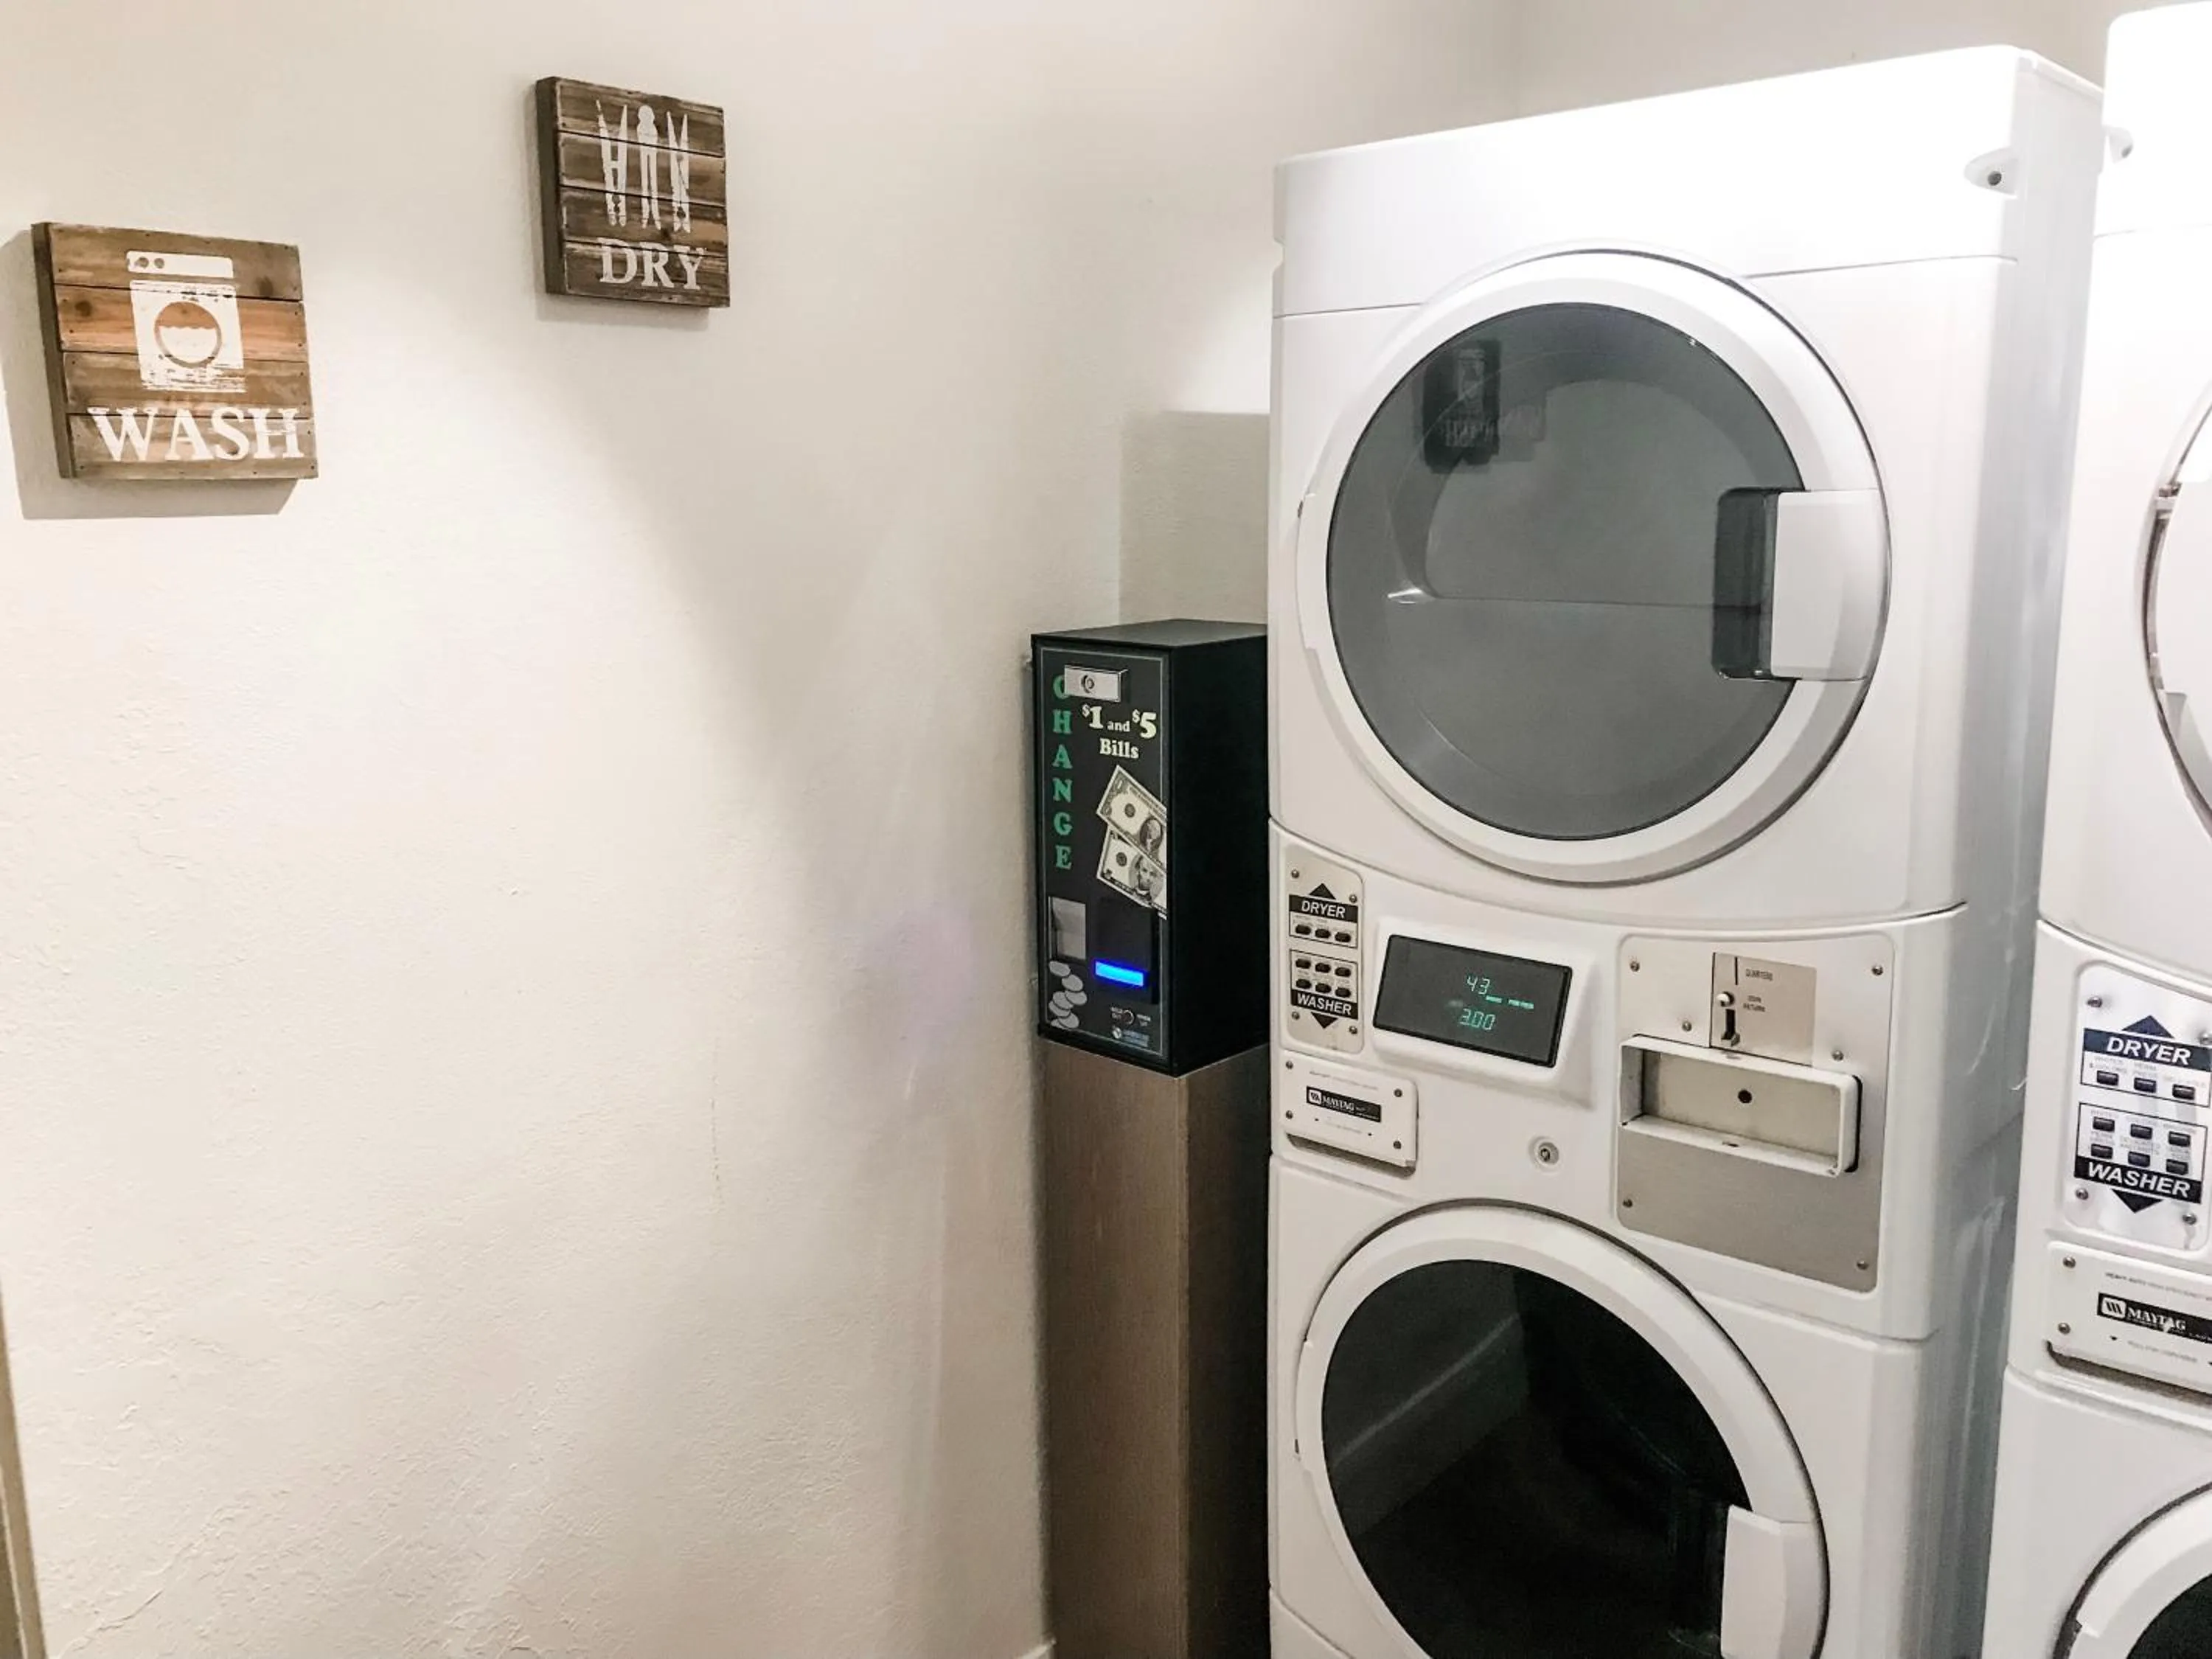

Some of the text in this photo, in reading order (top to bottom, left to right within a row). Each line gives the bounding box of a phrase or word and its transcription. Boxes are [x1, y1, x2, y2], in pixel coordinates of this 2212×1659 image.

[598, 239, 706, 291] DRY
[87, 406, 304, 463] WASH
[1082, 703, 1158, 740] $1 and $5
[1099, 737, 1139, 759] Bills
[1301, 900, 1346, 919] DRYER
[1466, 973, 1490, 996] 43
[1296, 992, 1352, 1015] WASHER
[2105, 1036, 2191, 1066] DRYER
[2087, 1161, 2191, 1198] WASHER
[2128, 1307, 2186, 1331] MAYTAG
